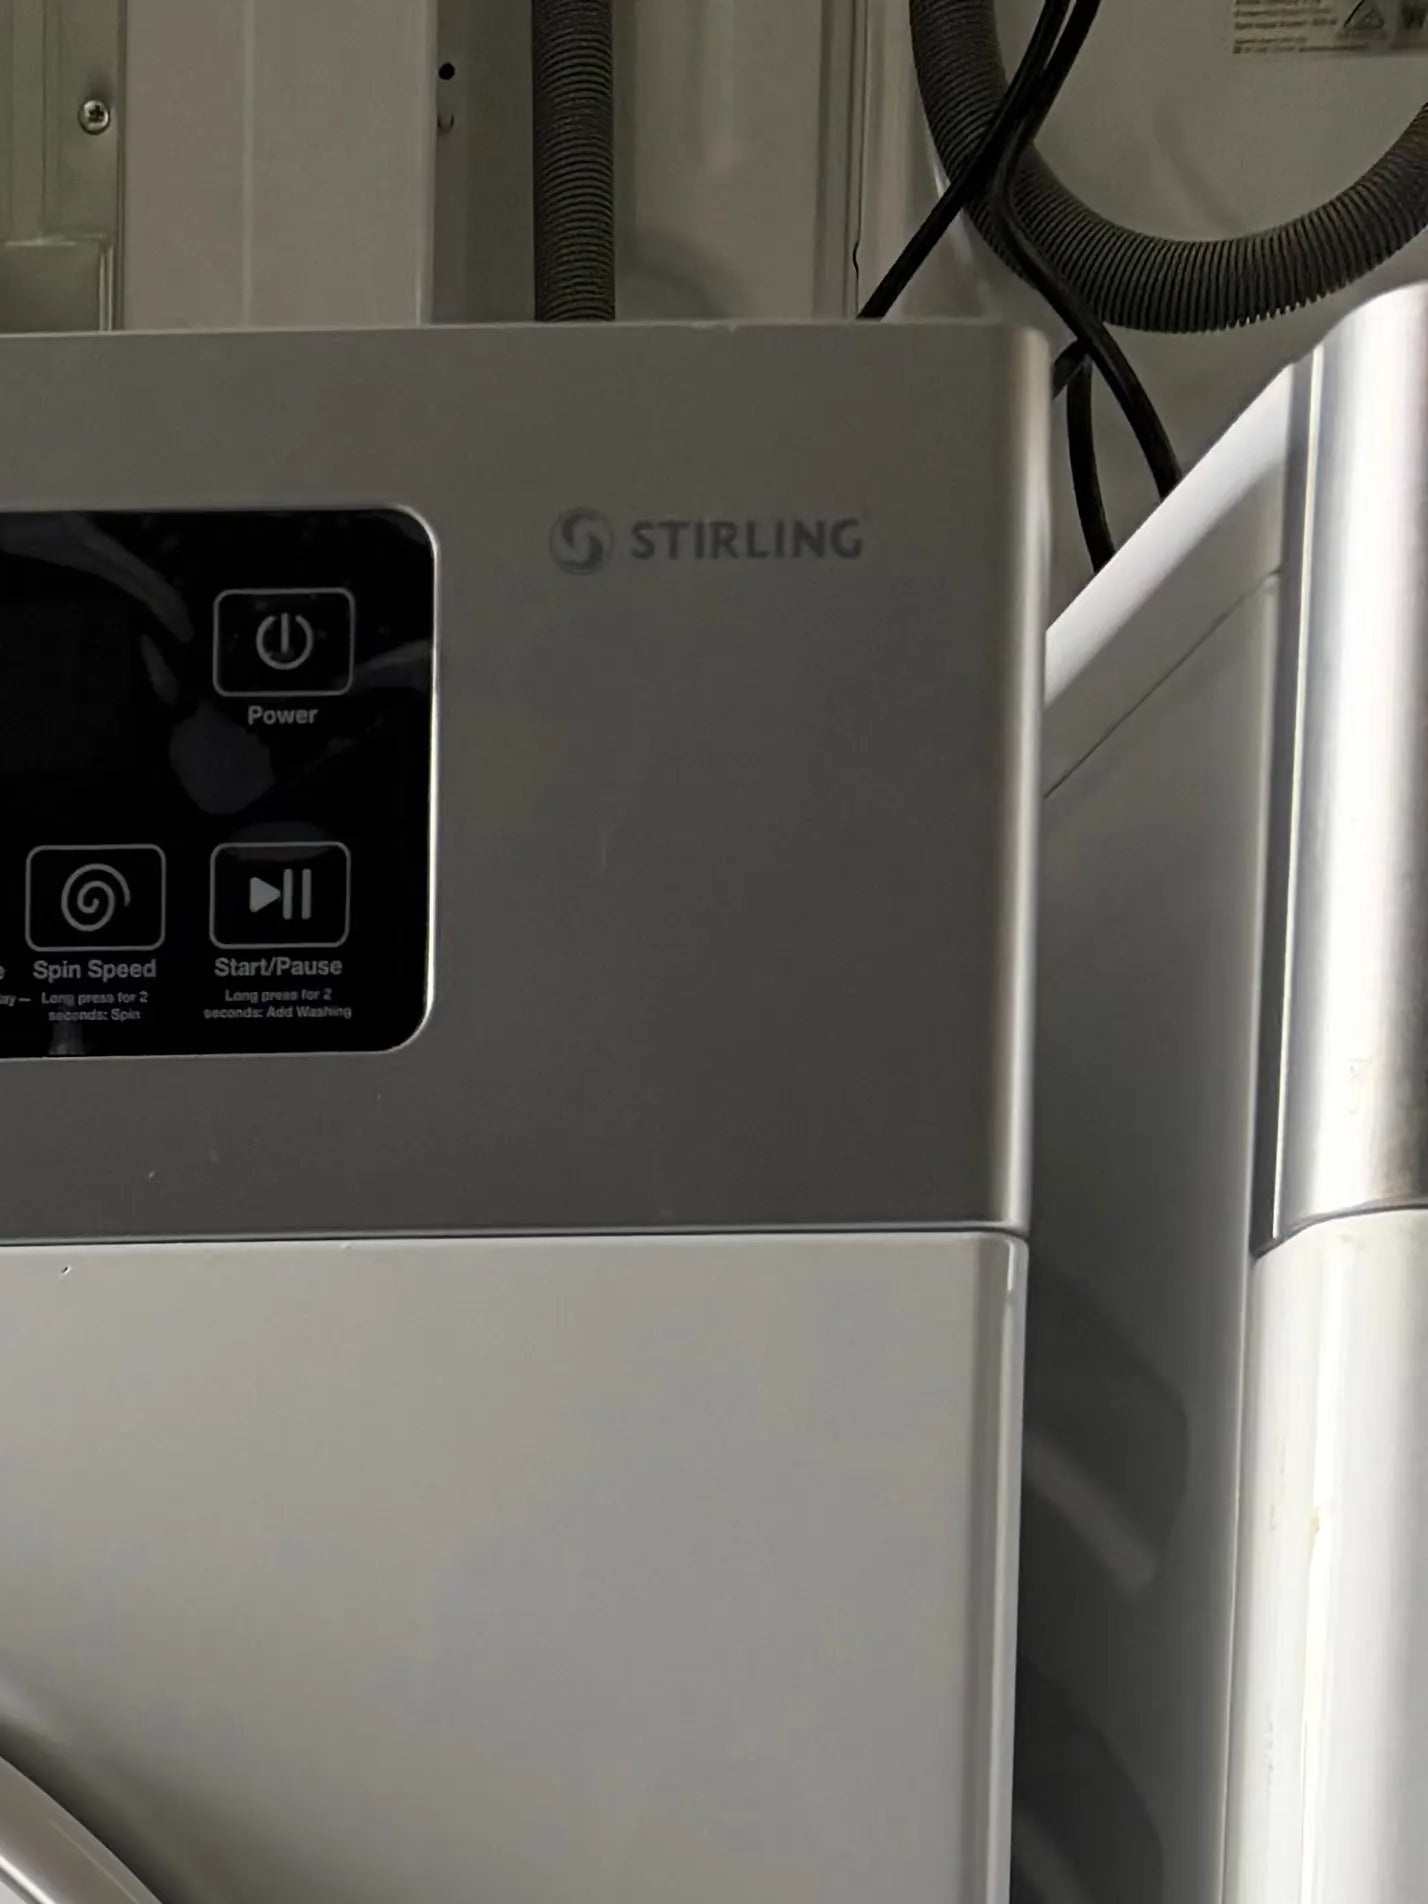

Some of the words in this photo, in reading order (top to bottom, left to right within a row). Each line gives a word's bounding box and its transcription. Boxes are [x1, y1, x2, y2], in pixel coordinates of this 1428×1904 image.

[631, 518, 863, 560] STIRLING
[248, 705, 318, 725] Power
[32, 960, 82, 983] Spin
[88, 959, 156, 982] Speed
[214, 957, 342, 976] Start/Pause
[78, 994, 115, 1006] press
[117, 992, 137, 1003] for
[139, 991, 148, 1002] 2
[225, 990, 258, 1003] Long
[261, 991, 298, 1002] press
[301, 989, 320, 1000] for
[323, 988, 332, 1000] 2
[110, 1008, 141, 1022] Spin
[266, 1006, 293, 1017] Add
